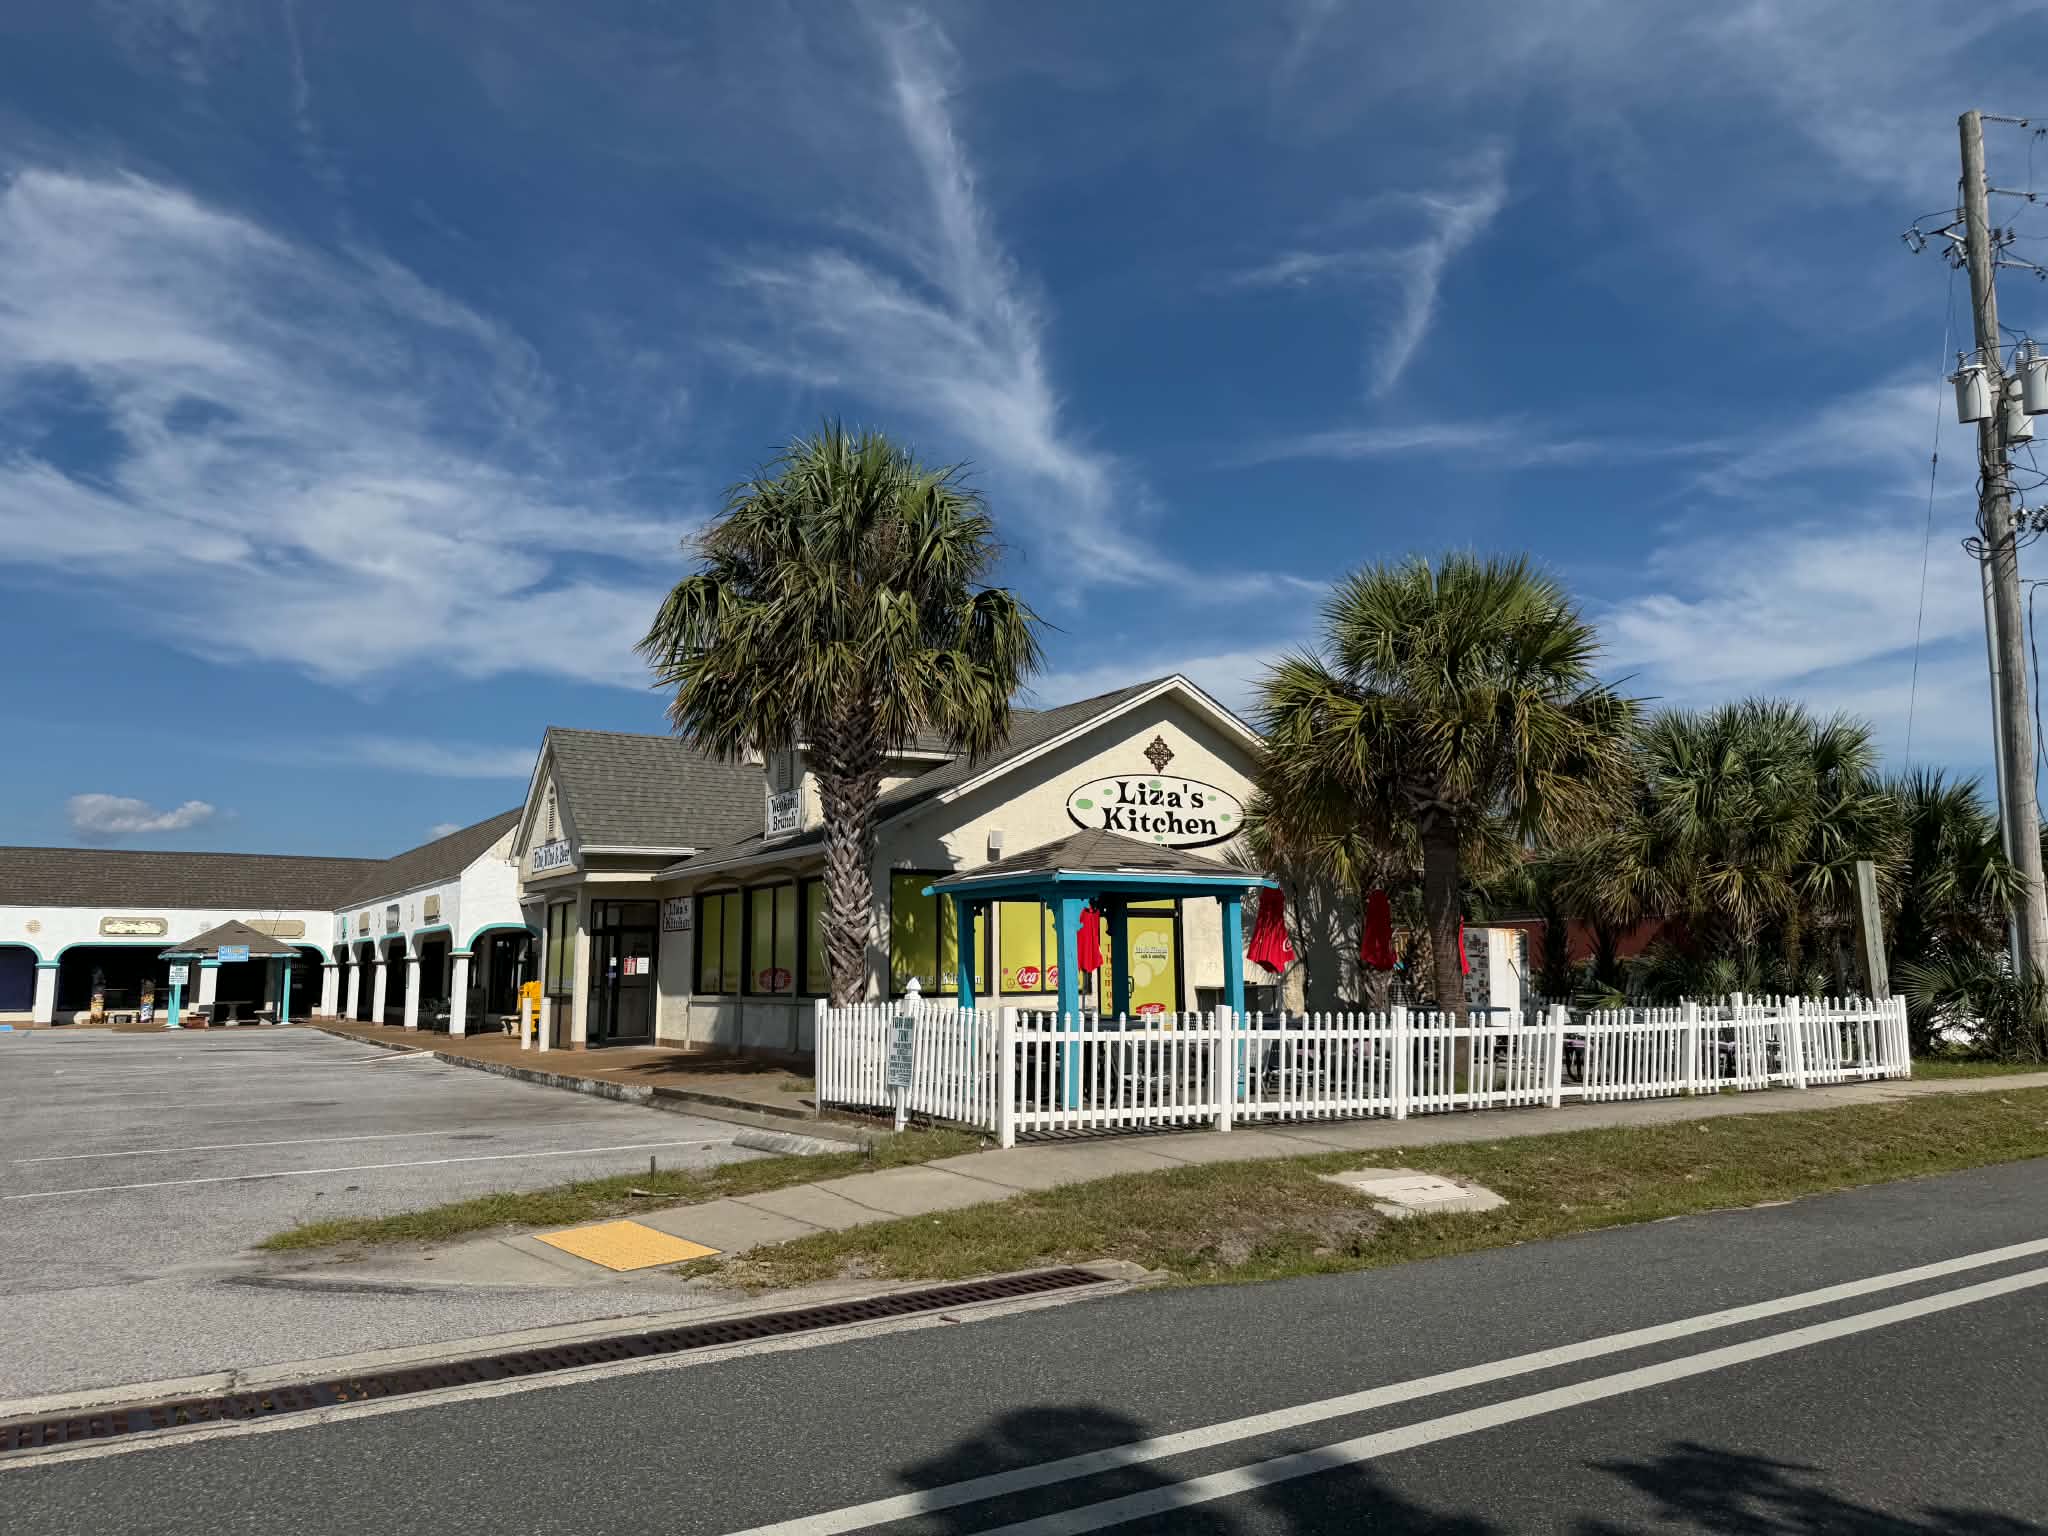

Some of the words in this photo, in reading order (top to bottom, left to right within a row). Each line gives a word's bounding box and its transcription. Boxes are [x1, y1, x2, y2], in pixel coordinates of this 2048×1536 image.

[771, 792, 799, 814] Weekend
[1115, 781, 1204, 808] Liza's
[773, 811, 796, 831] Brunch
[1101, 806, 1218, 835] Kitchen
